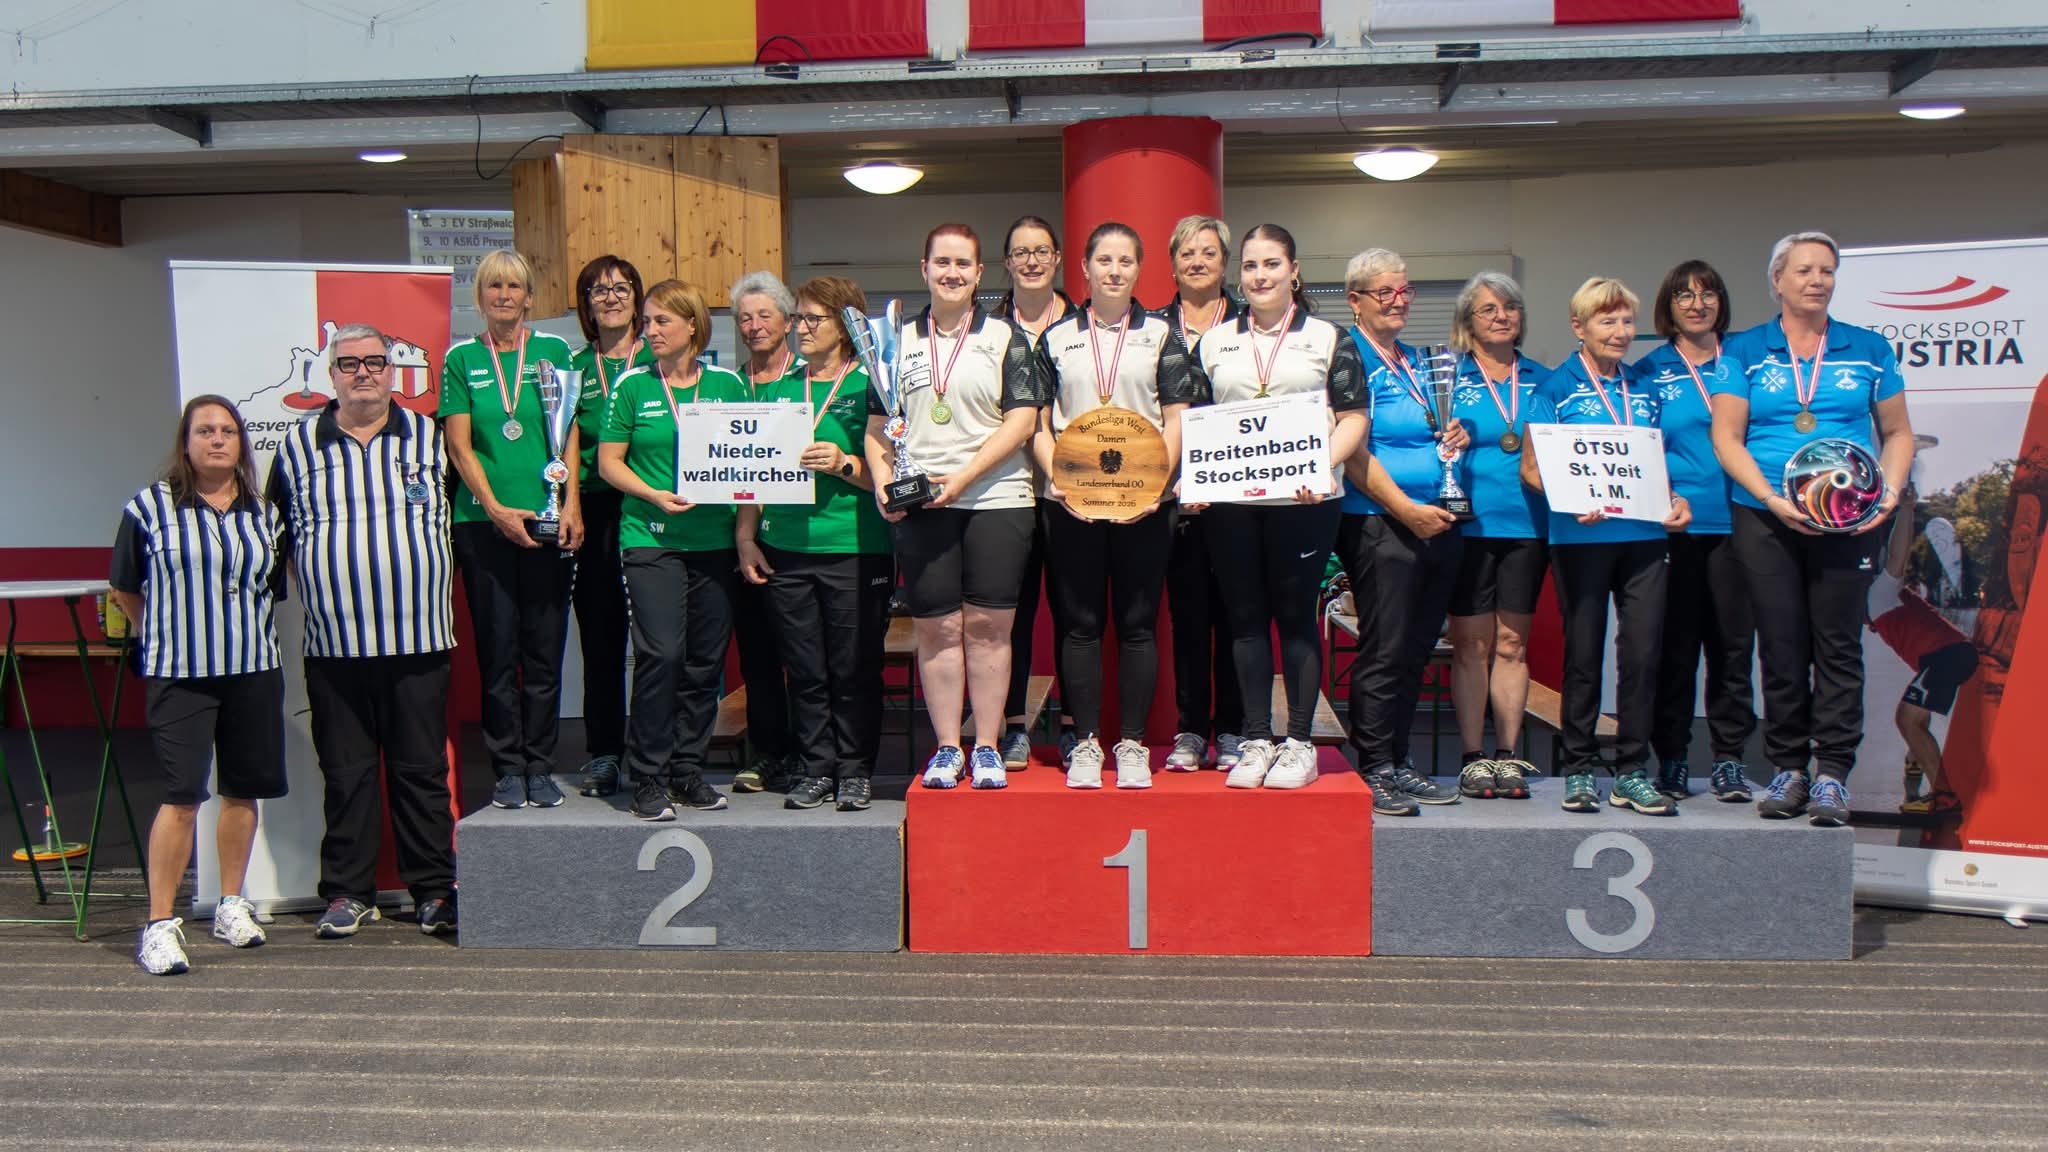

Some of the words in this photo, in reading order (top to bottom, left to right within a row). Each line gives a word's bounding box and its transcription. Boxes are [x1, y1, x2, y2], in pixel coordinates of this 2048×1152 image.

[452, 218, 465, 228] EV
[467, 217, 513, 230] Straßwalc
[423, 236, 433, 246] 9.
[453, 233, 480, 247] ASKÖ
[482, 236, 513, 249] Pregar
[454, 255, 472, 265] ESV
[1865, 319, 2026, 341] TOCKSPORT
[1064, 342, 1085, 352] JAKO
[1219, 345, 1240, 353] JAKO
[1895, 338, 2024, 368] USTRIA
[905, 351, 924, 361] JAKO
[730, 419, 758, 435] SU
[1079, 412, 1125, 434] Bundesliga
[1127, 416, 1146, 435] West
[1238, 415, 1268, 434] SV
[1097, 434, 1126, 443] Damen
[708, 443, 782, 459] Nieder-
[1189, 434, 1322, 464] Breitenbach
[1573, 438, 1629, 456] ÖTSU
[683, 466, 809, 482] waldkirchen
[1194, 459, 1317, 484] Stocksport
[1568, 462, 1597, 476] St.
[1603, 463, 1642, 479] Veit
[1588, 484, 1602, 498] i.
[1607, 484, 1631, 499] M.
[1082, 497, 1116, 507] Sommer
[649, 521, 665, 534] SW
[637, 827, 717, 946] 2
[1103, 828, 1148, 950] 1
[1565, 831, 1656, 954] 3
